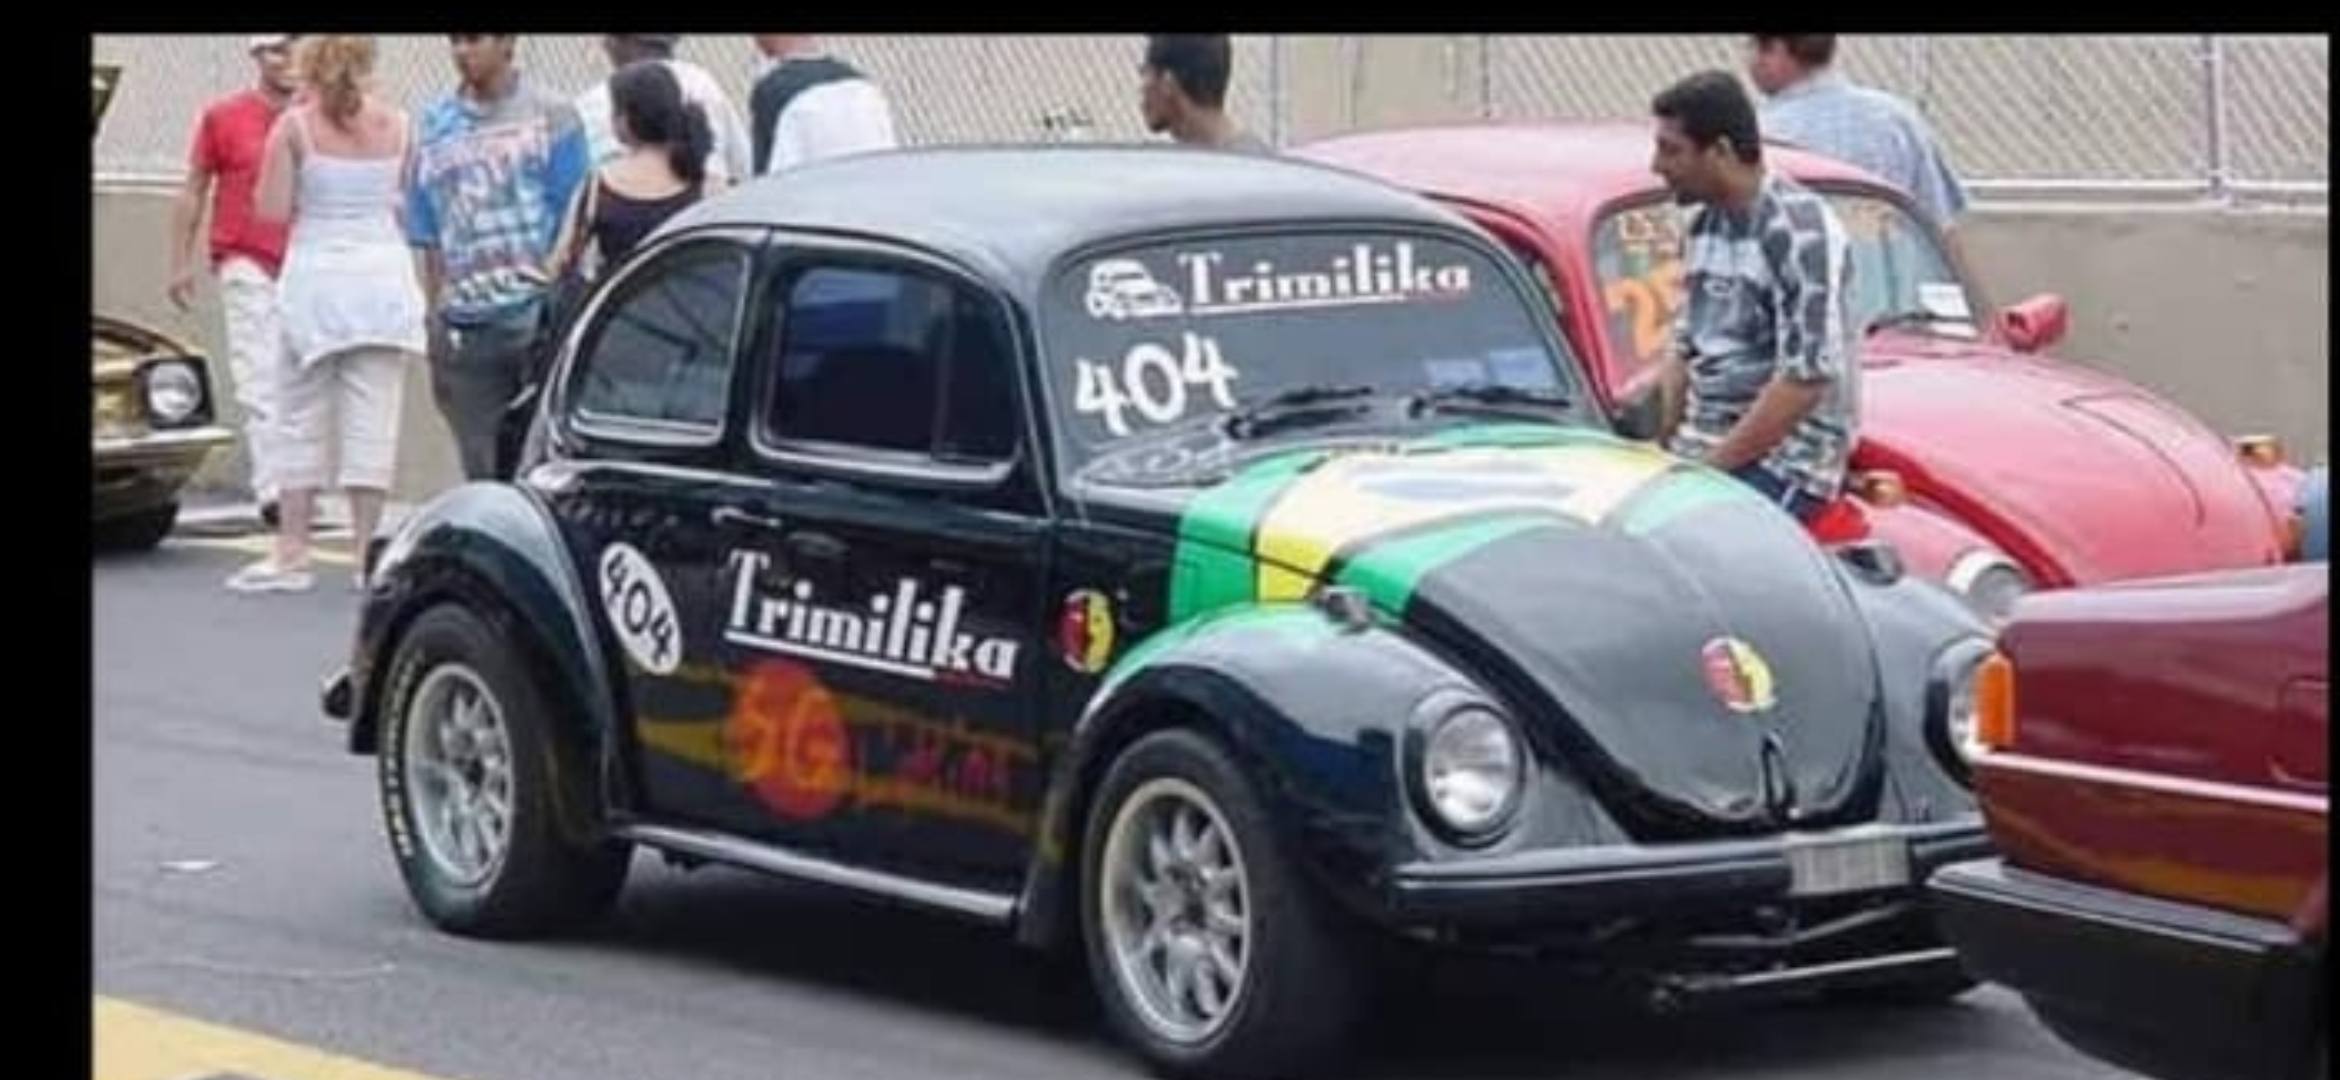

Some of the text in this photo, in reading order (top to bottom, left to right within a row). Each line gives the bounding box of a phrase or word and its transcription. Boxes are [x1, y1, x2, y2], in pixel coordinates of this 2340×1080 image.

[1178, 240, 1471, 306] Trimilika
[1075, 332, 1239, 436] 404
[605, 548, 677, 666] 404
[725, 549, 1019, 680] Trimilika
